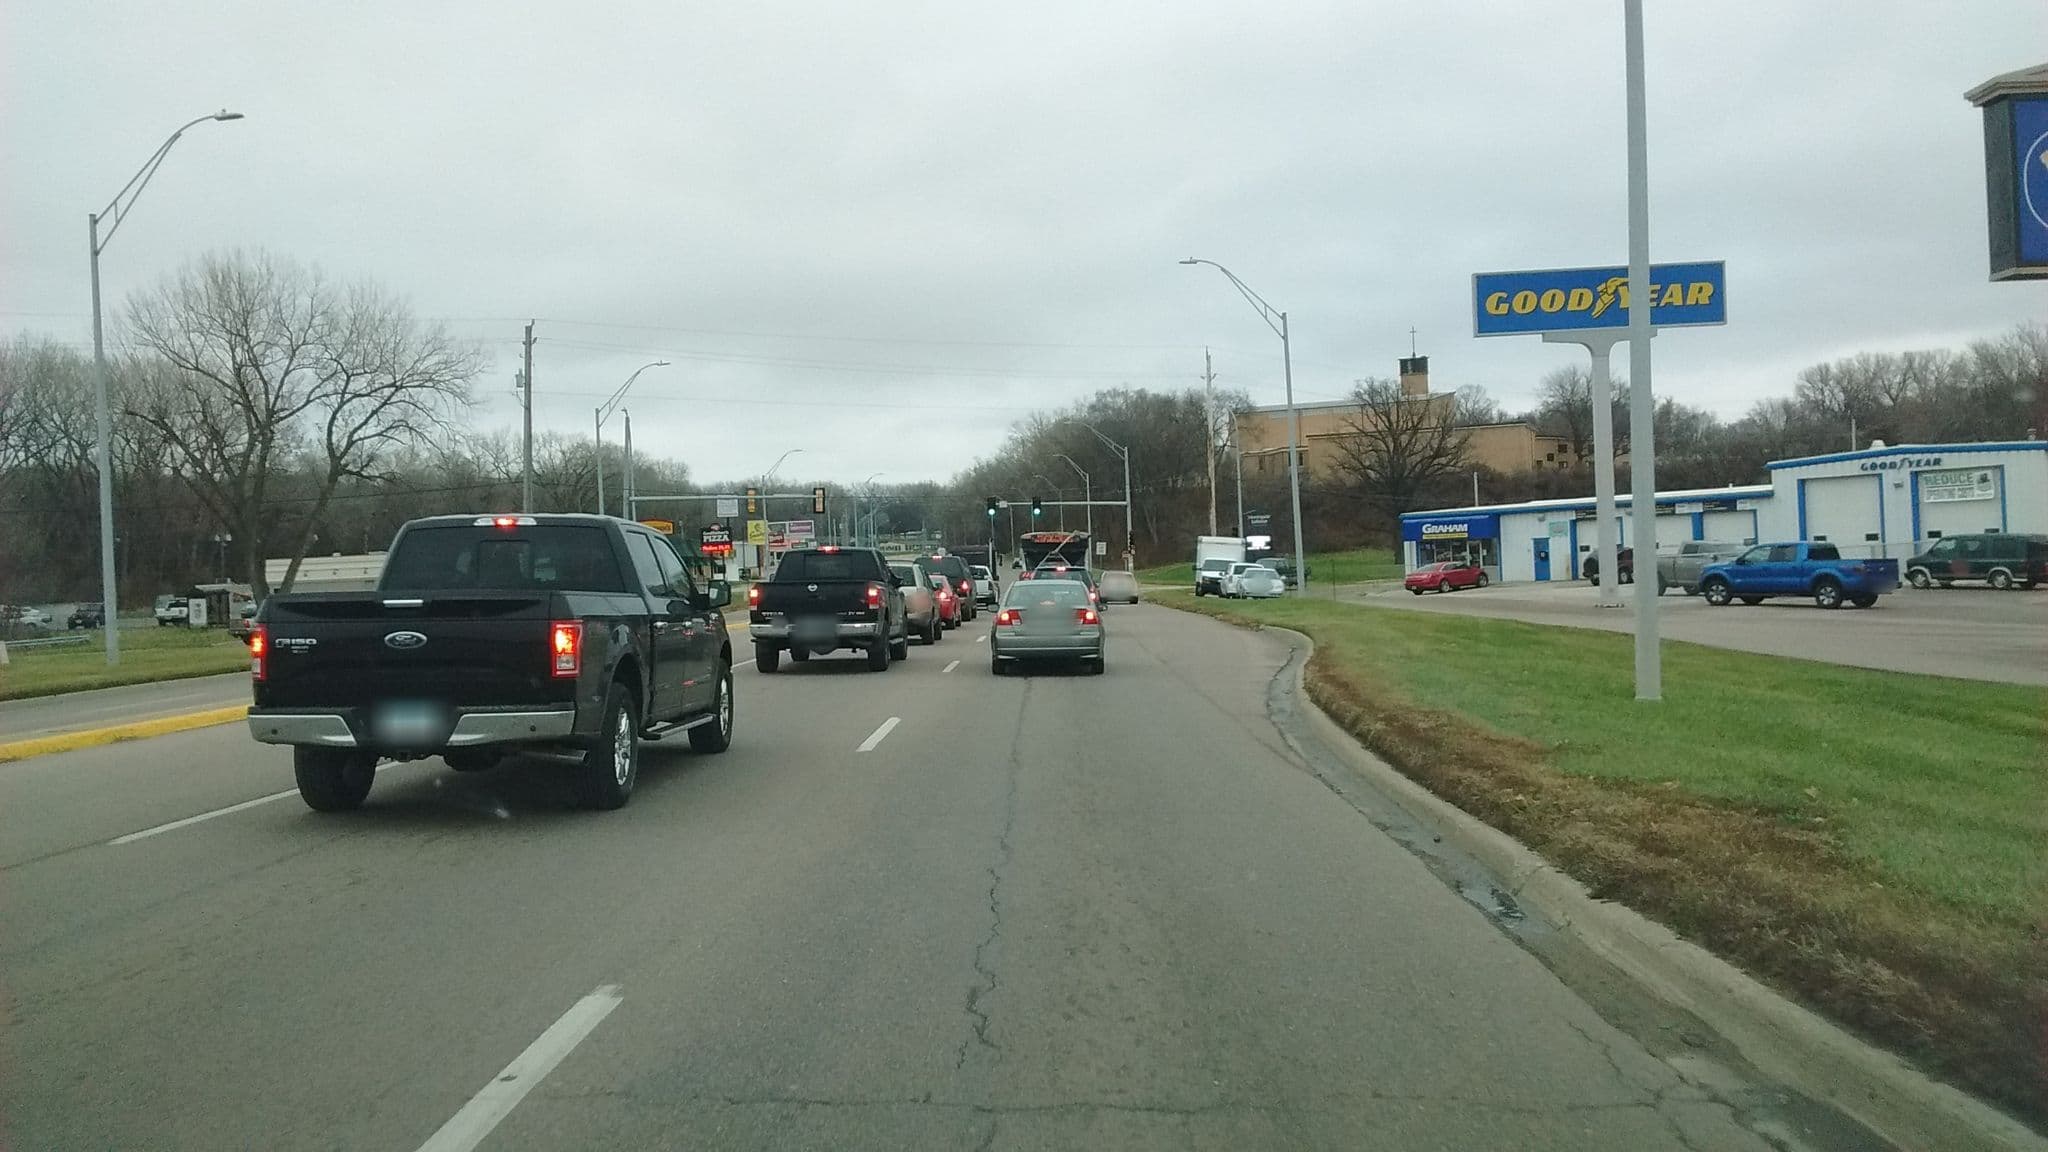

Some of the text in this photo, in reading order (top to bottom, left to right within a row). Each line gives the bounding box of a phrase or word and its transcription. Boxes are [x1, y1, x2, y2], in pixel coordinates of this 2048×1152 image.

[1860, 457, 1942, 471] GOODYEAR
[1924, 473, 1974, 486] REDUCE
[1422, 523, 1468, 534] GRAHAM
[703, 535, 729, 543] PIZZA
